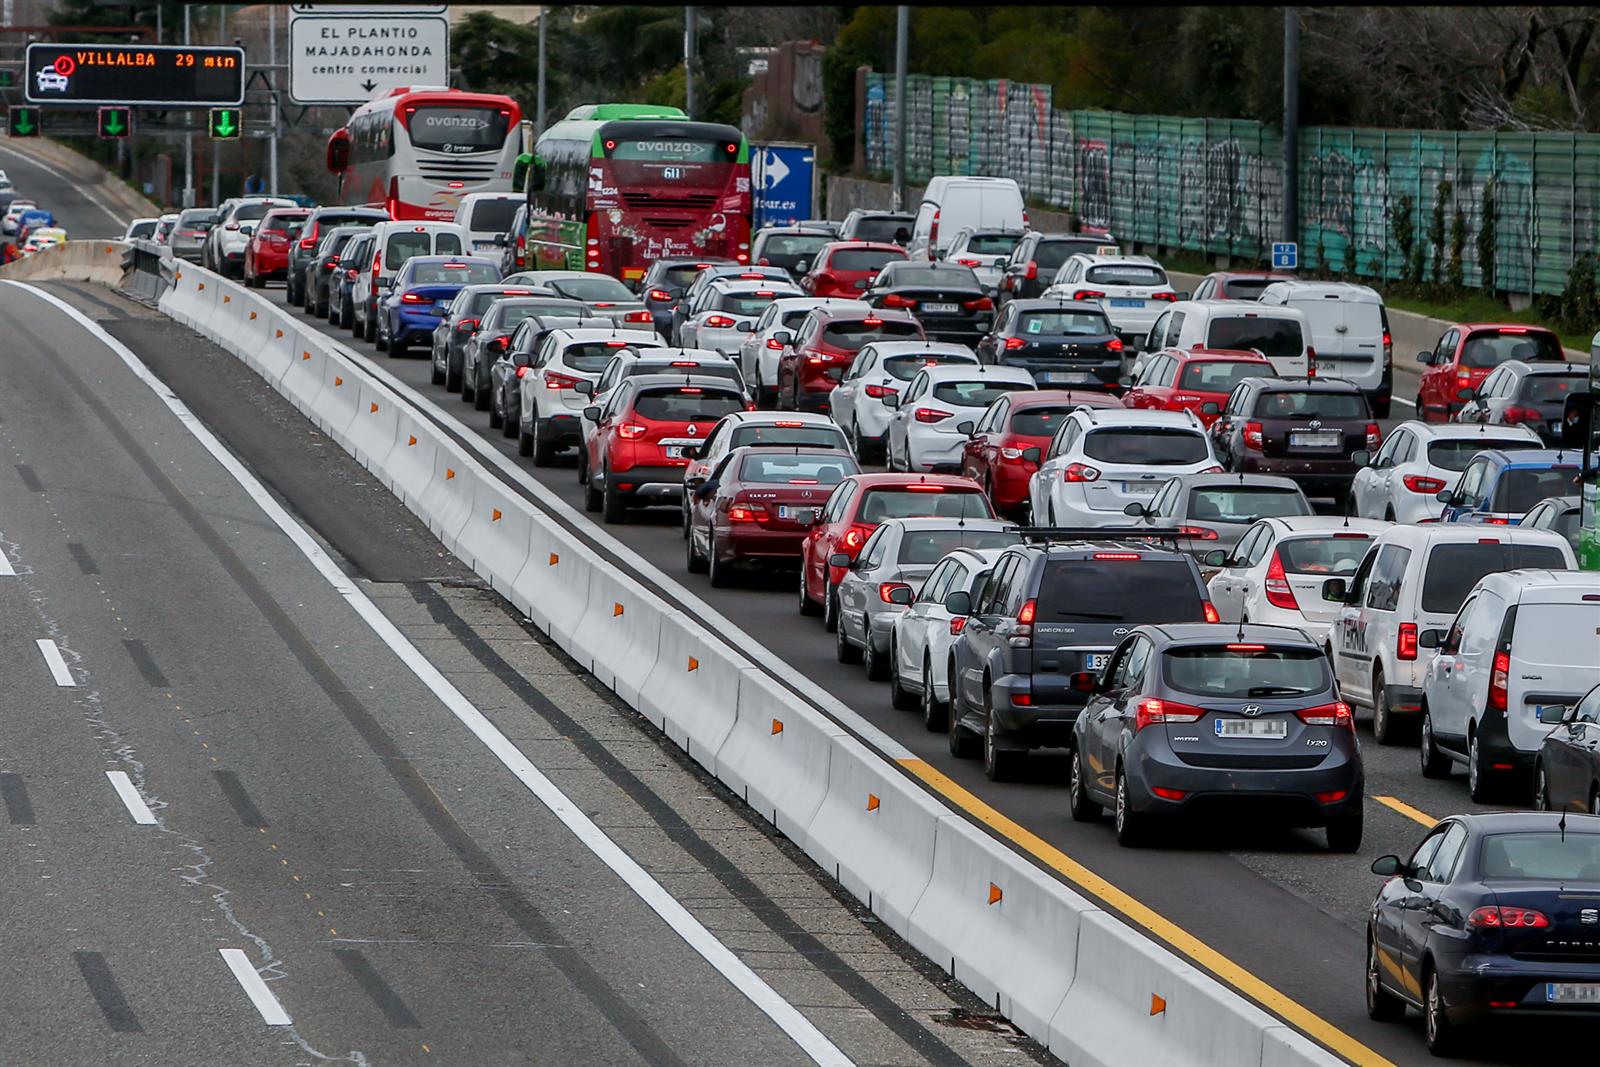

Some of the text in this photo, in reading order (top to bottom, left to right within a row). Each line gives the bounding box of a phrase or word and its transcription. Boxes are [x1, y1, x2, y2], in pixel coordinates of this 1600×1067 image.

[321, 27, 418, 38] EL PLANTIO
[305, 46, 432, 56] MAJADAHONDA
[77, 51, 235, 68] VILLALBA 29 min
[312, 64, 427, 74] centro comercial
[426, 117, 476, 127] avanza
[637, 141, 691, 152] avanza
[664, 167, 680, 179] 611
[1281, 255, 1289, 265] 8
